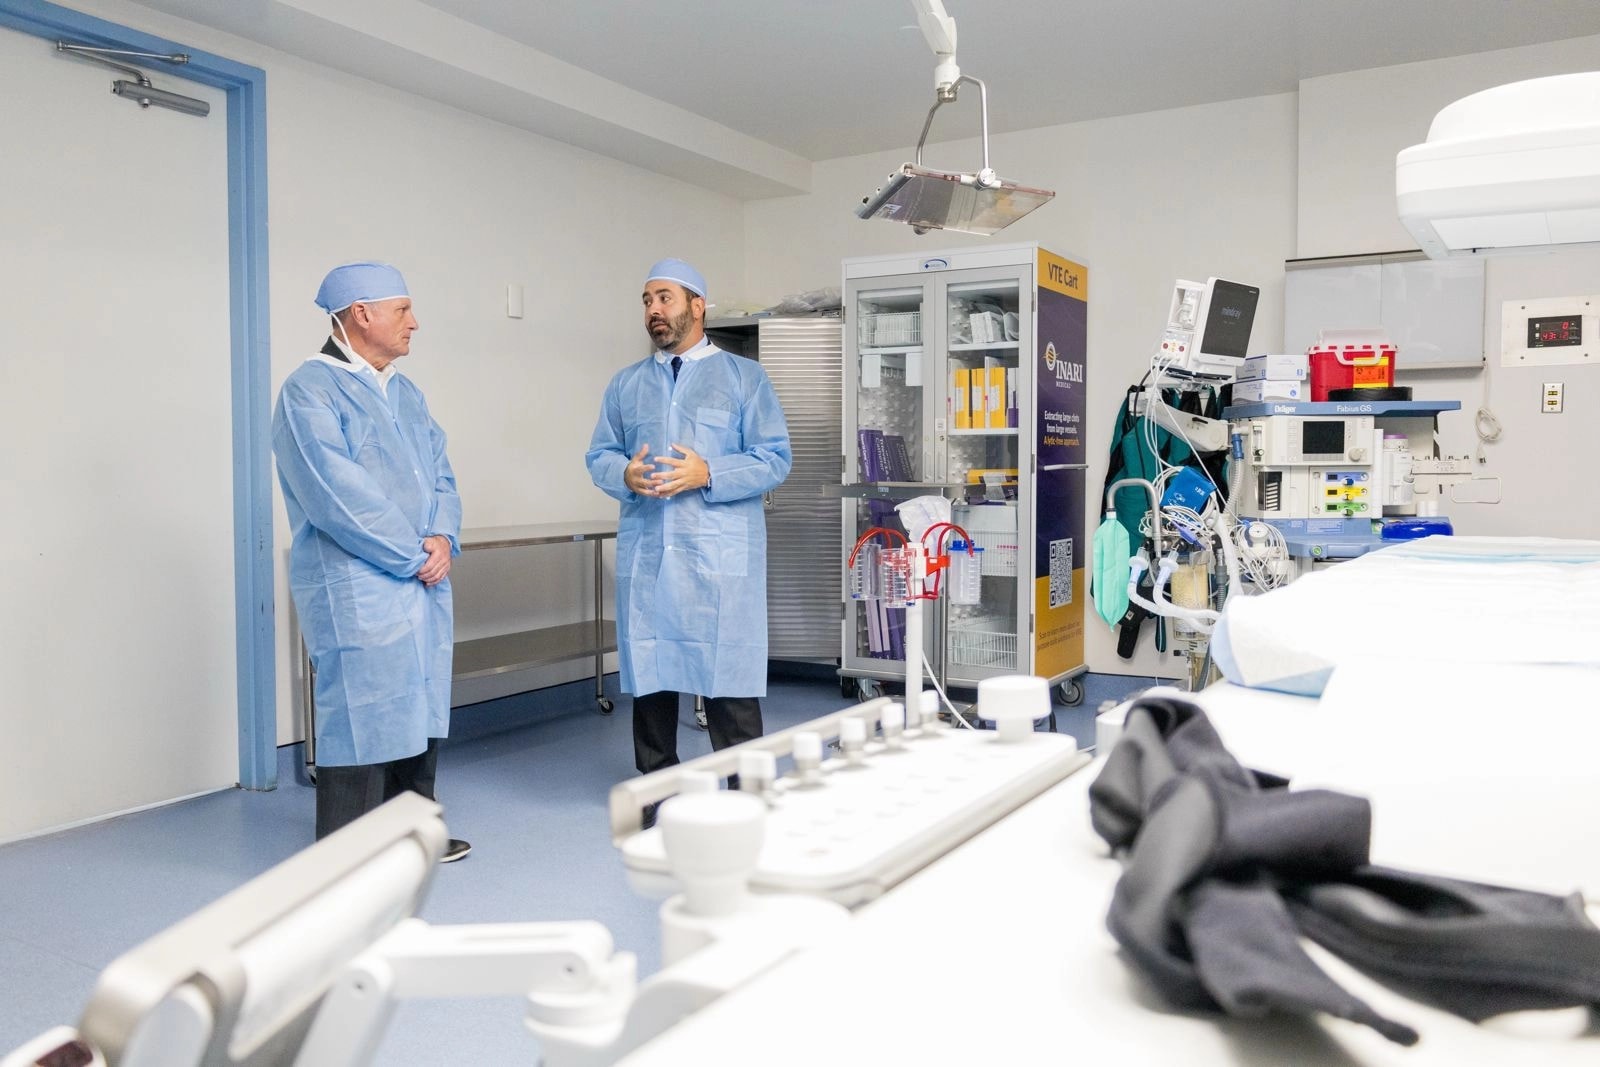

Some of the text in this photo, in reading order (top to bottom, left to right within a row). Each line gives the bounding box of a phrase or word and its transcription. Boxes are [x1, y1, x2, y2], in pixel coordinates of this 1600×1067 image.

[1048, 262, 1078, 290] VTE Cart
[1056, 360, 1082, 382] INARI
[1274, 405, 1296, 414] Dräger
[1044, 410, 1062, 423] Extracting
[1062, 412, 1071, 424] large
[1046, 422, 1055, 432] from
[1056, 424, 1064, 435] large
